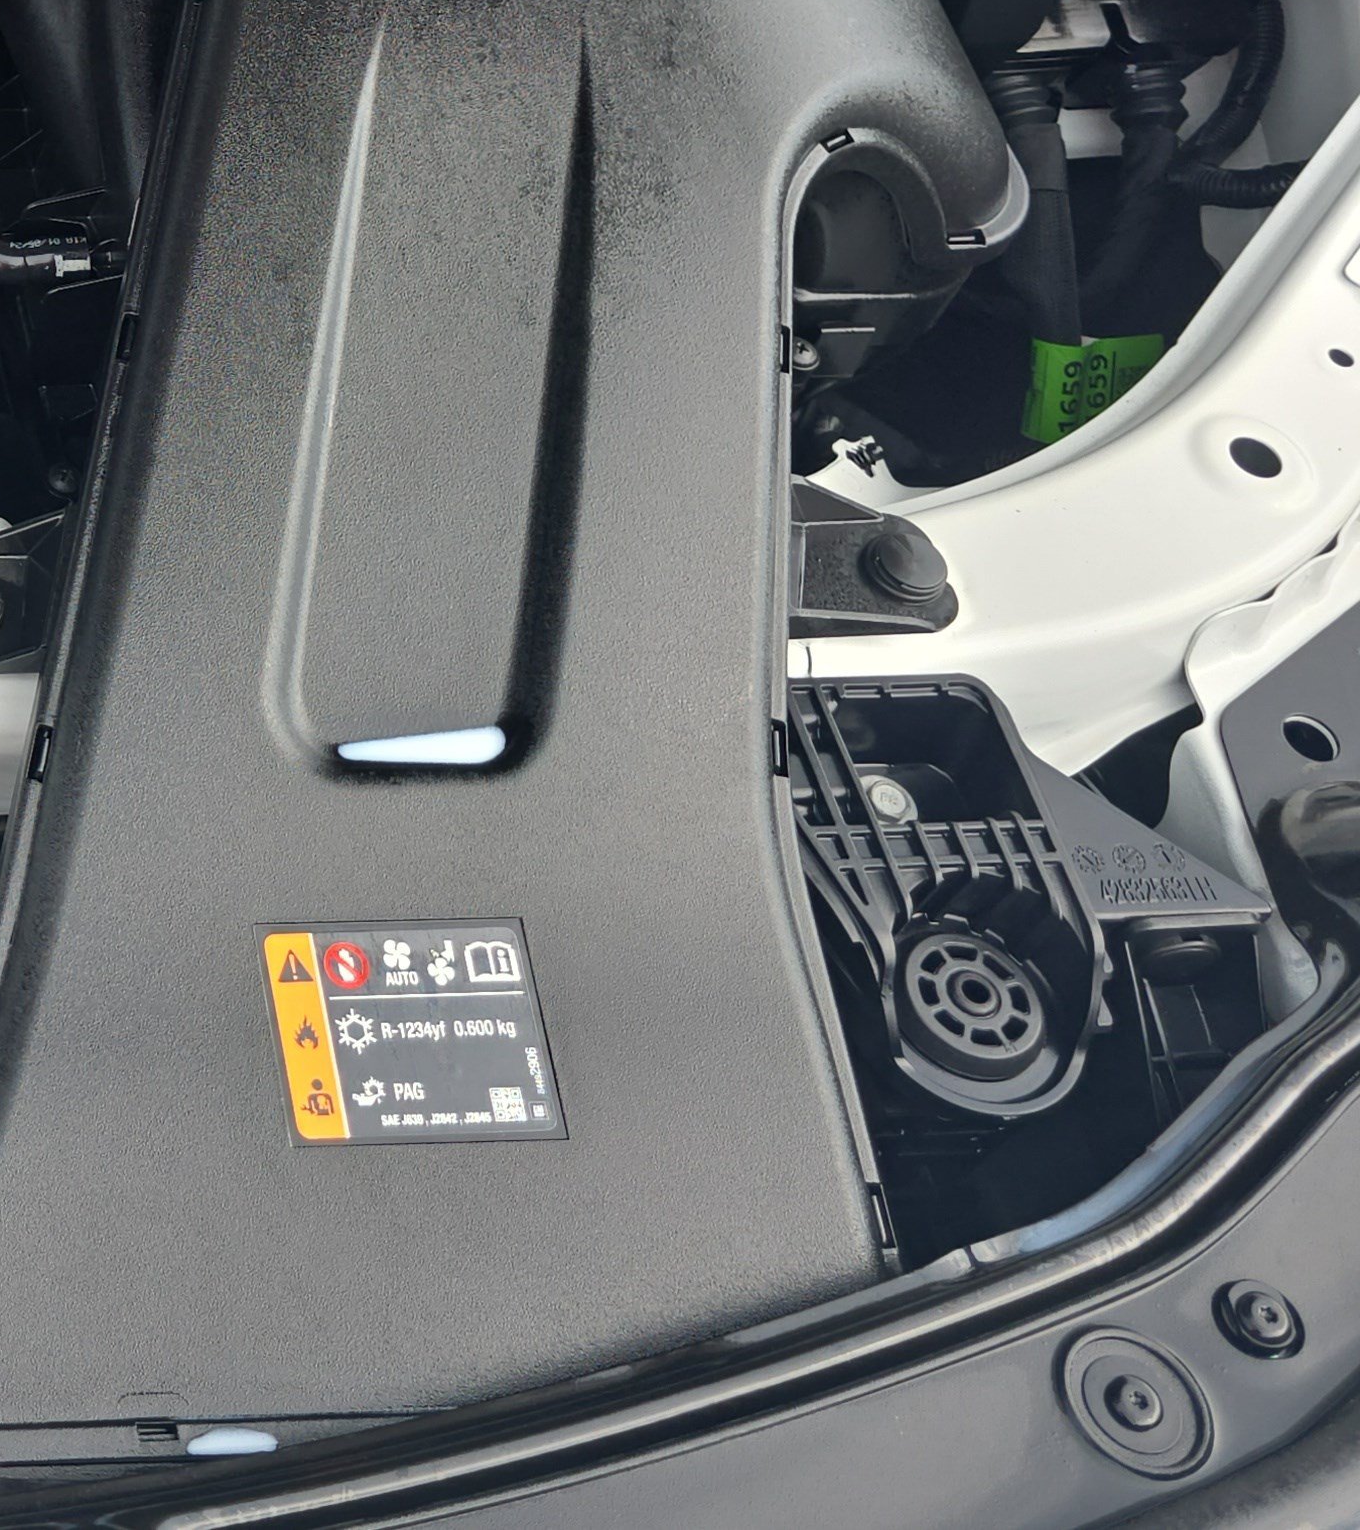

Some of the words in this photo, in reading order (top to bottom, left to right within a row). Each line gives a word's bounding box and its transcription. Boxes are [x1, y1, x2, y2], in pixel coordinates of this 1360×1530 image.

[385, 971, 419, 986] AUTO
[380, 1022, 446, 1041] R-1234yf
[454, 1020, 495, 1037] 0.600
[497, 1020, 517, 1039] kg
[393, 1083, 425, 1101] PAG
[381, 1114, 401, 1126] SAE
